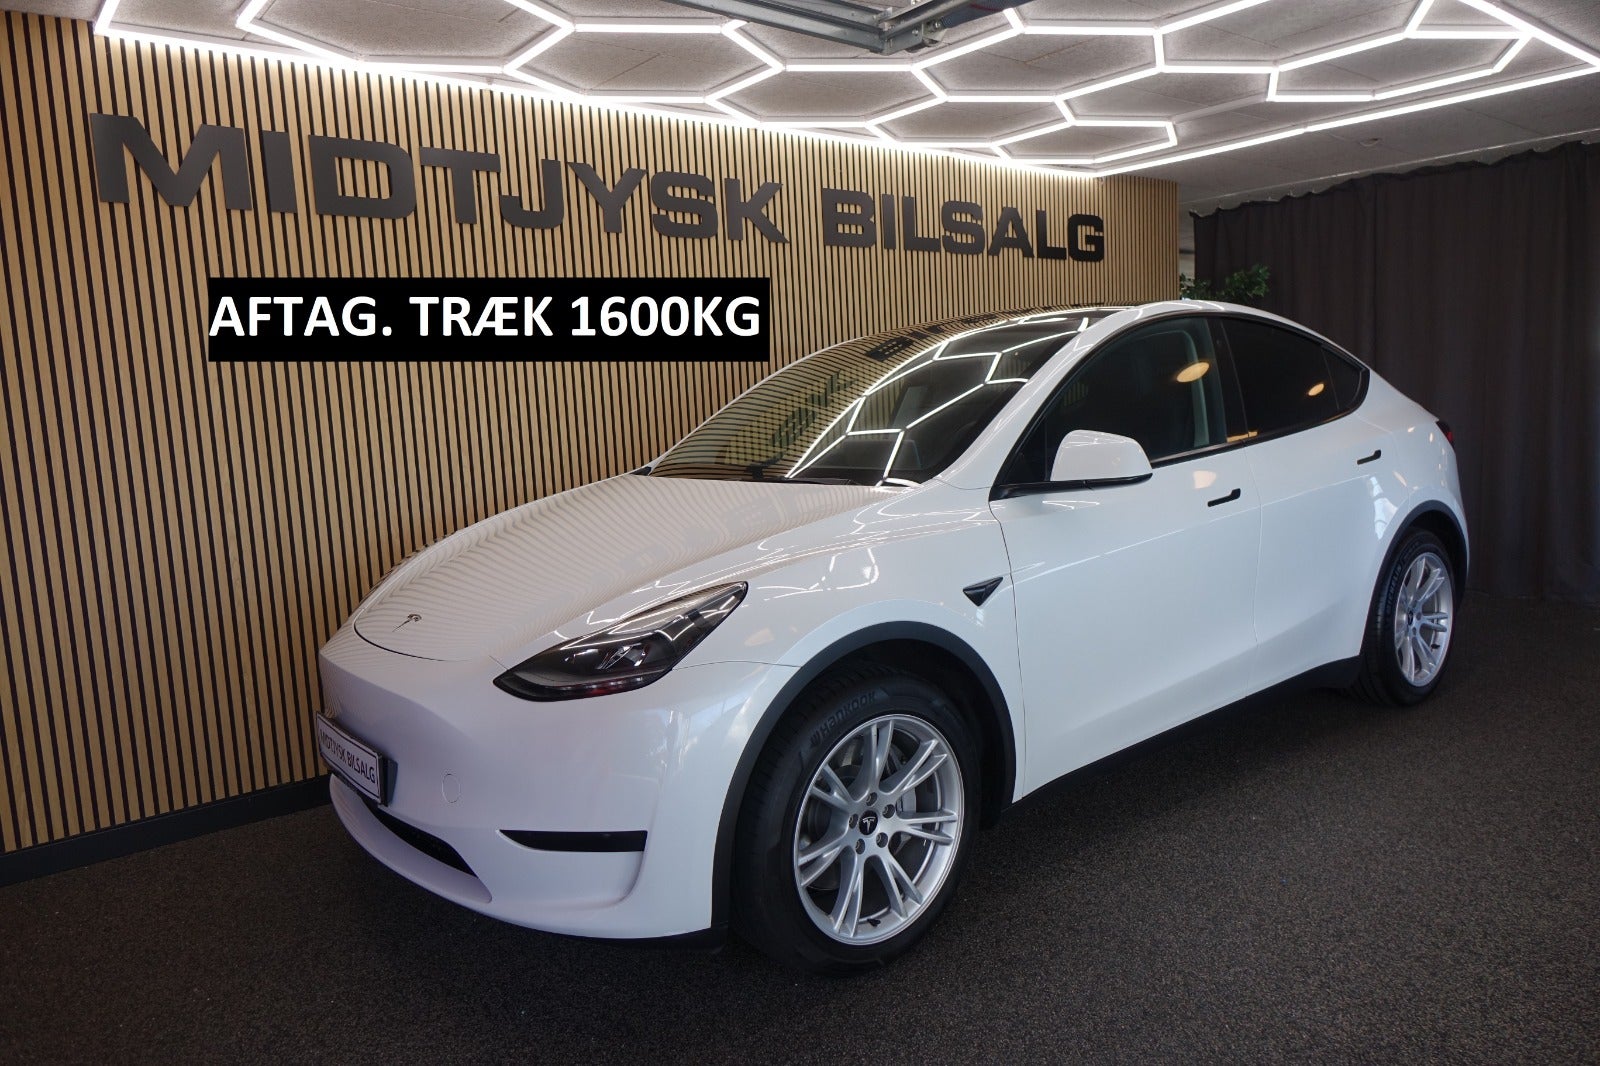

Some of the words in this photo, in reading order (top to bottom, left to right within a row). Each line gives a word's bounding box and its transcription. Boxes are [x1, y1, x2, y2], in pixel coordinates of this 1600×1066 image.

[89, 112, 790, 244] MIDTJYSK
[821, 187, 1105, 263] BILSALG
[346, 751, 376, 783] BILSALG
